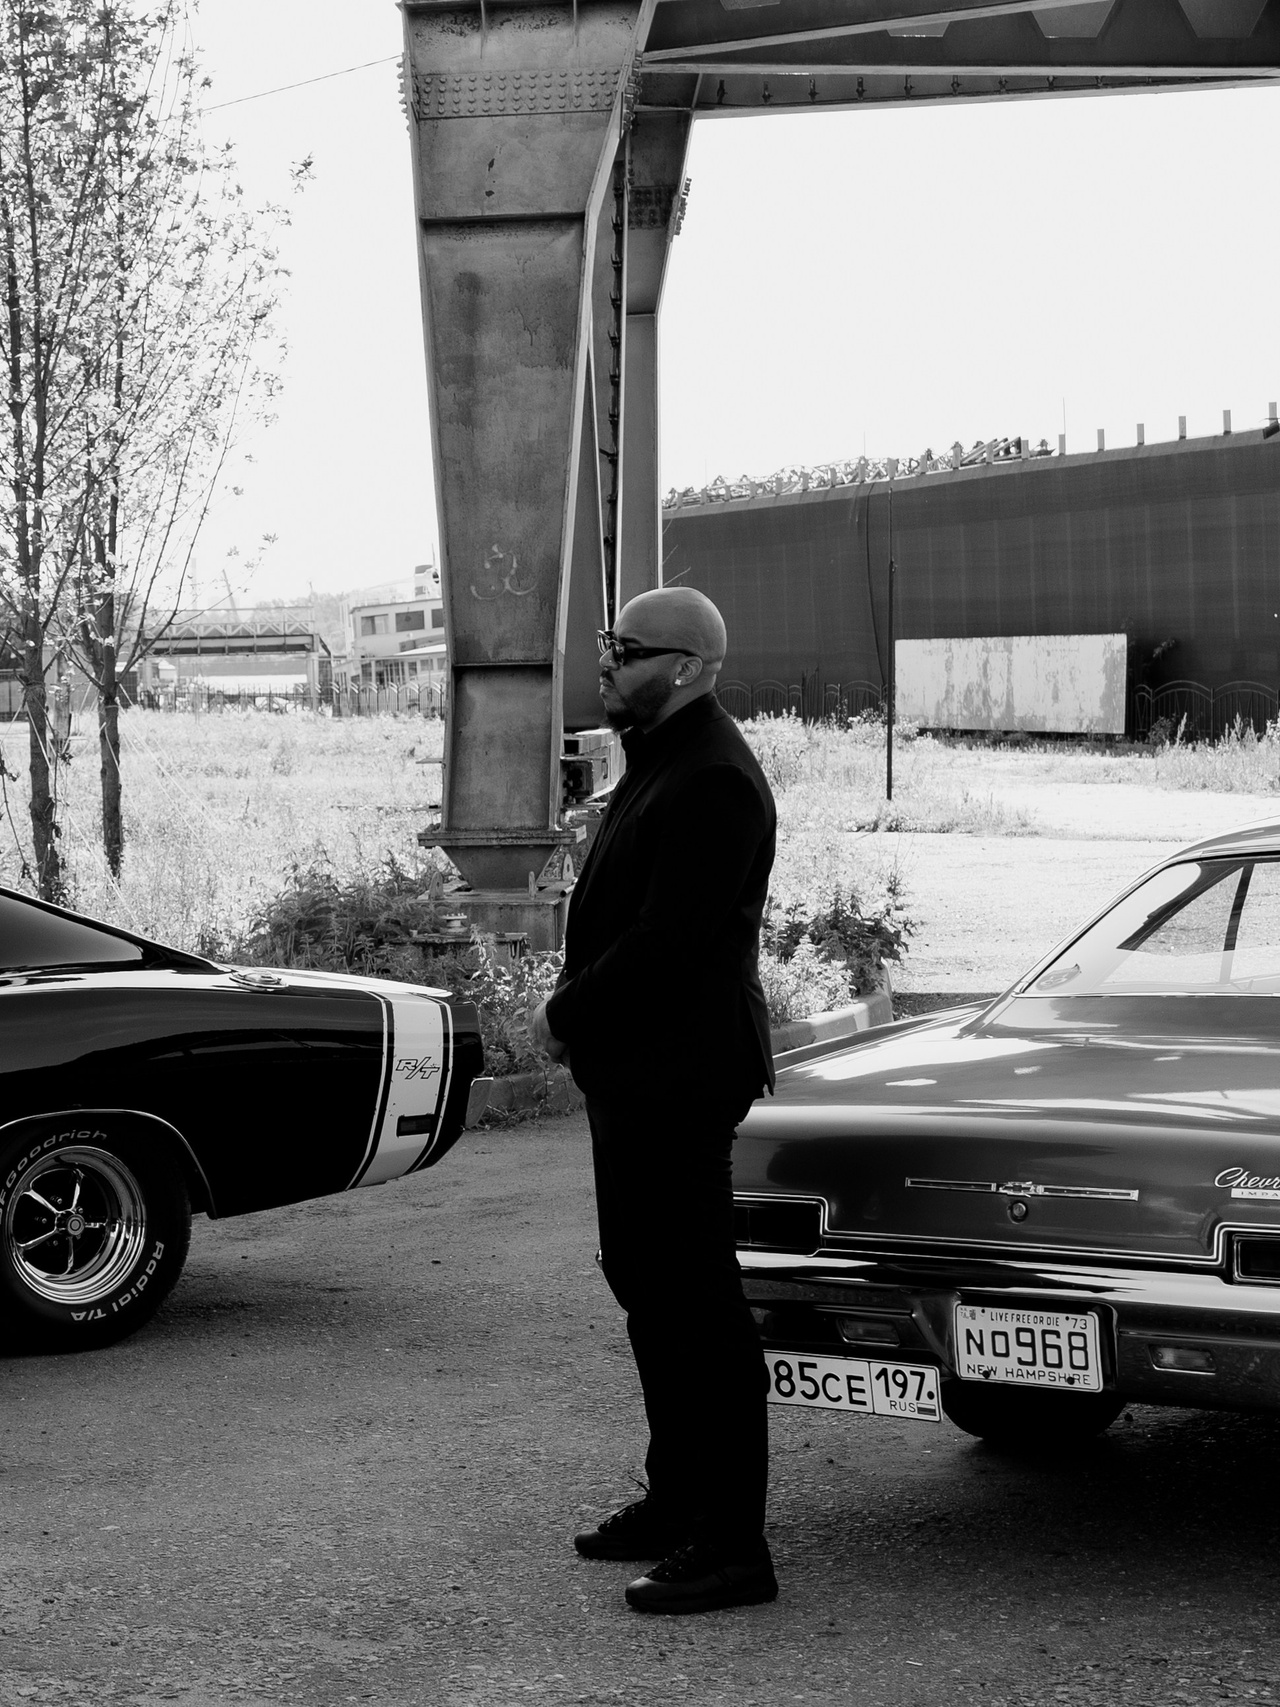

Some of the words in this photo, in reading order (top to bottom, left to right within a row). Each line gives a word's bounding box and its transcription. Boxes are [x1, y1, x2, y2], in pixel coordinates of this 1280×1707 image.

[395, 1056, 441, 1080] R/T
[111, 1241, 165, 1312] Radial
[70, 1308, 108, 1321] T/A
[990, 1311, 1009, 1323] LIVE
[1011, 1313, 1031, 1325] FREE
[1033, 1315, 1044, 1326] OR
[1046, 1316, 1060, 1327] DIE
[1070, 1318, 1088, 1330] 73
[966, 1363, 998, 1377] NEW
[875, 1367, 926, 1401] 197
[889, 1400, 917, 1413] RUS
